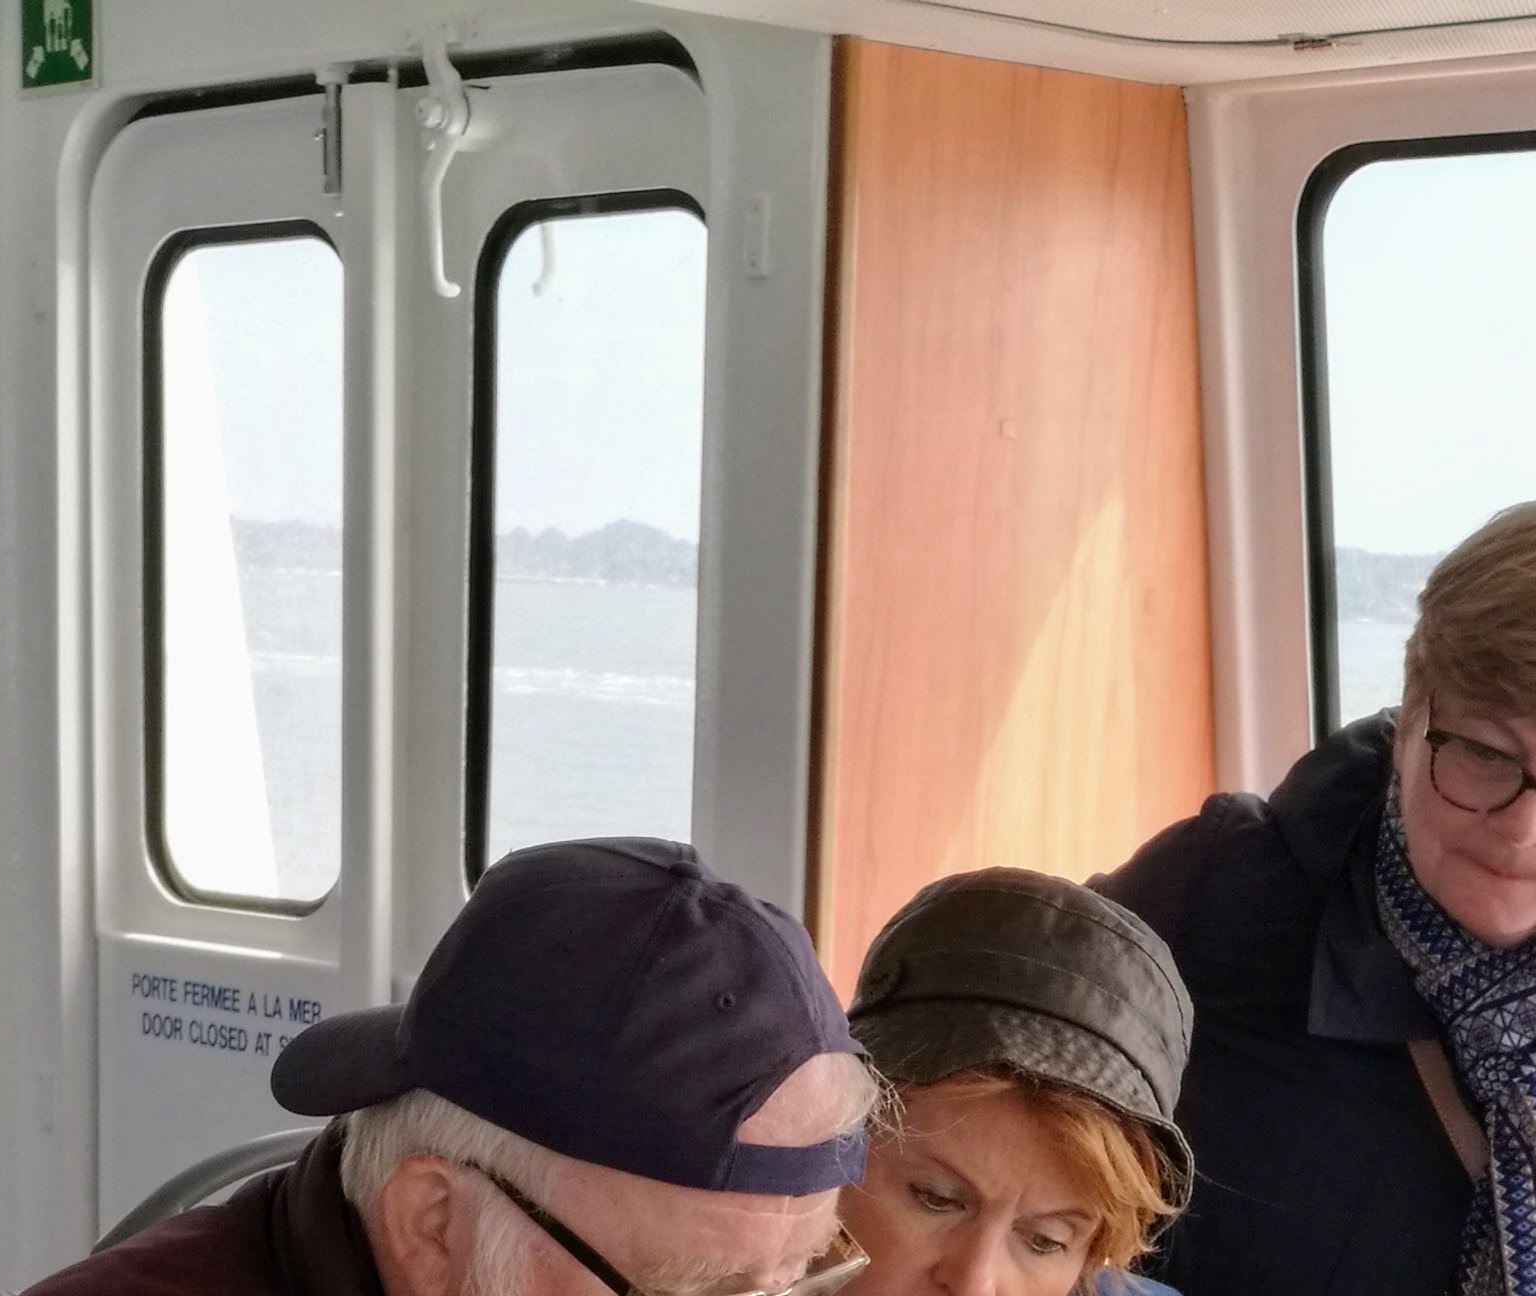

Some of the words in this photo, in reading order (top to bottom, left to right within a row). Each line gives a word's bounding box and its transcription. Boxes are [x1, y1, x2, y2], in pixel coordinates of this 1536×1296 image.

[132, 973, 177, 1002] PORTE
[184, 982, 241, 1013] FERMEE
[247, 991, 258, 1015] A
[263, 995, 283, 1020] LA
[289, 998, 322, 1024] MER
[142, 1012, 183, 1041] DOOR
[189, 1020, 248, 1052] CLOSED
[255, 1032, 273, 1056] AT
